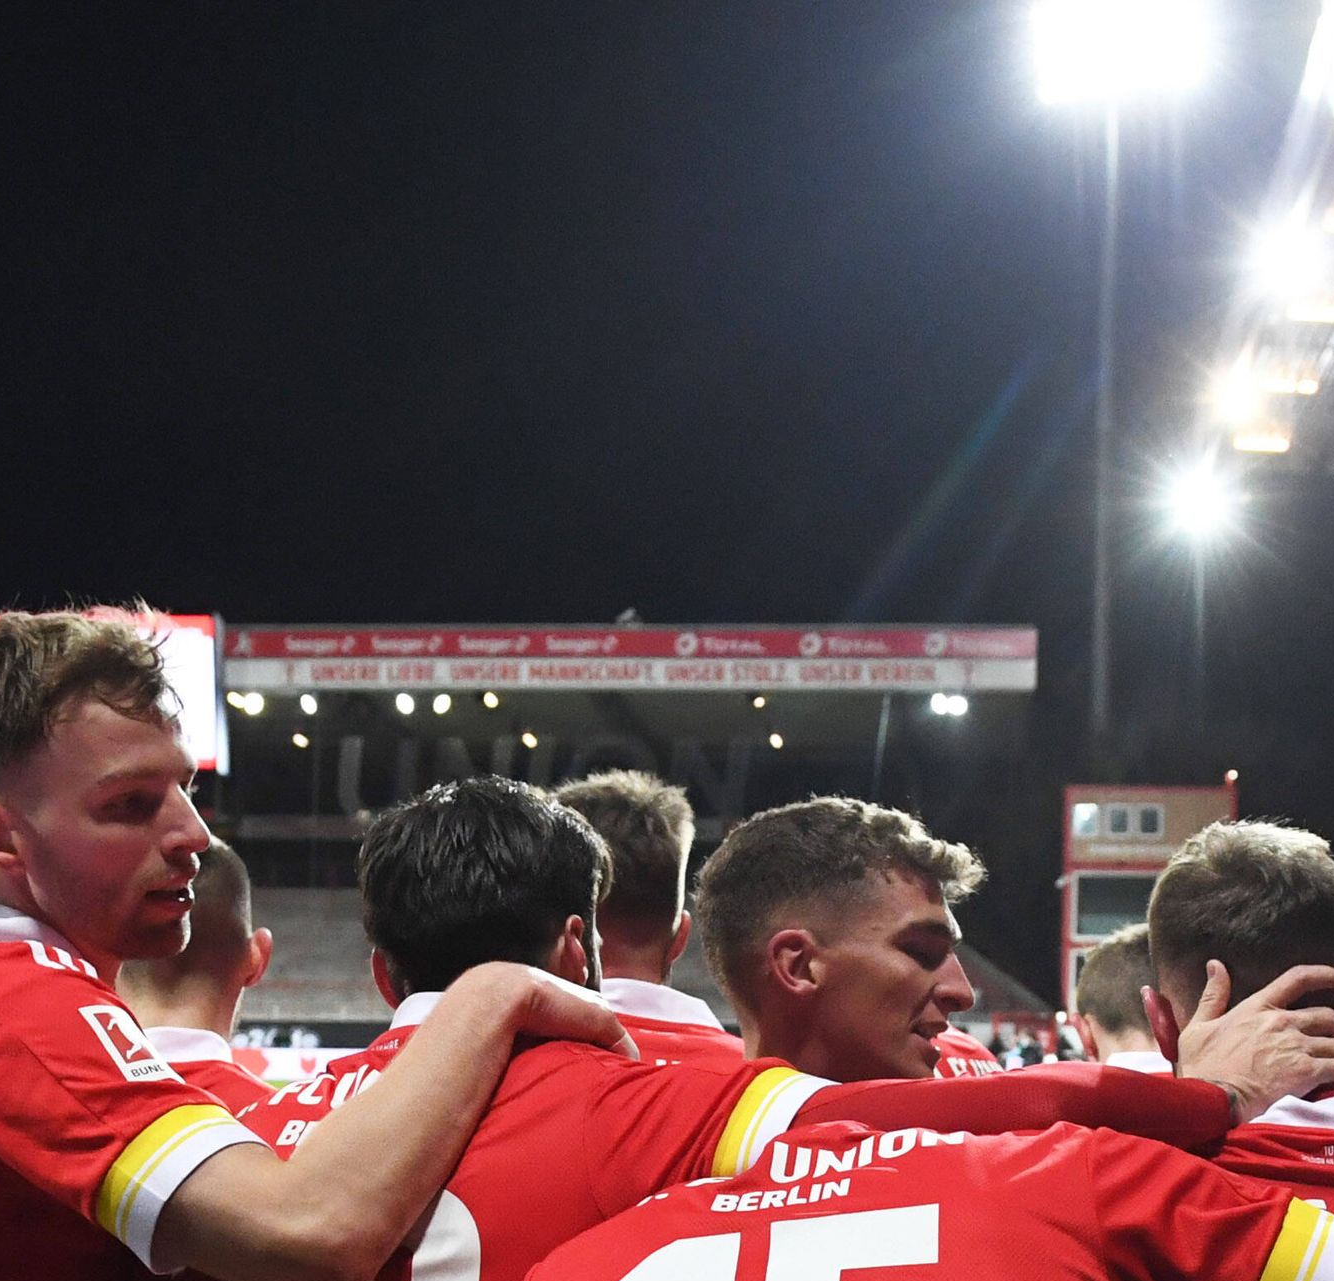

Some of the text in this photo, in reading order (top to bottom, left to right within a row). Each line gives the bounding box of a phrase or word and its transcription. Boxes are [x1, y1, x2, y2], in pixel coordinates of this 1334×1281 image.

[268, 1073, 338, 1106] FC
[770, 1128, 969, 1184] UNION
[710, 1177, 850, 1213] BERLIN
